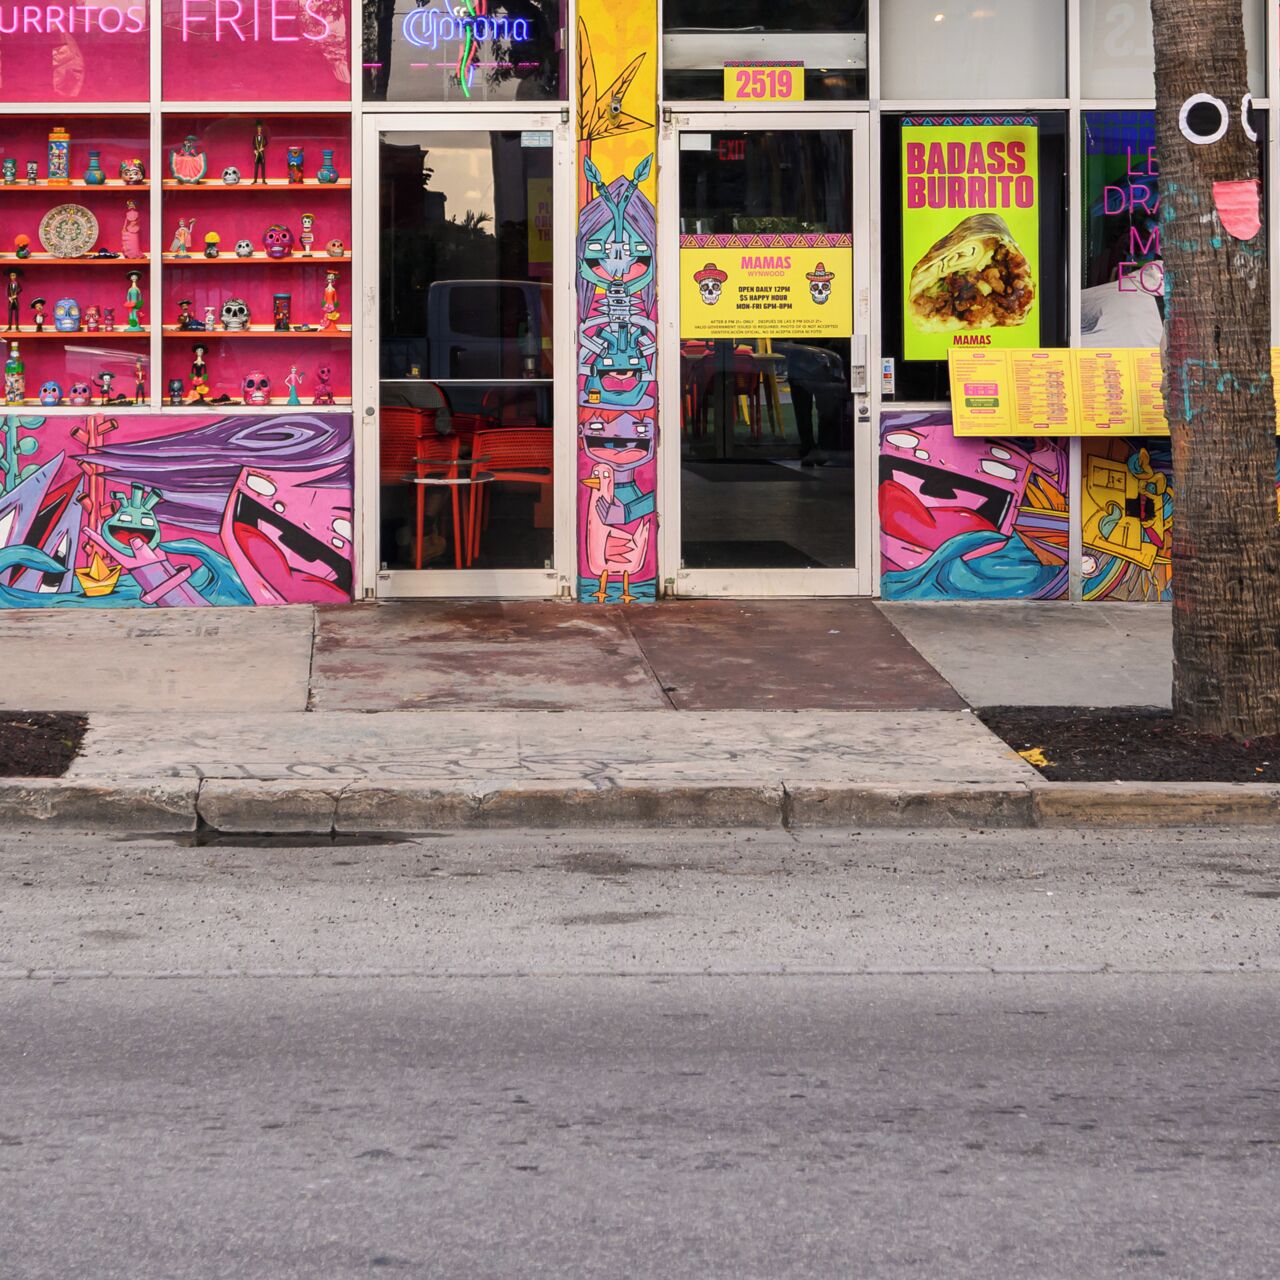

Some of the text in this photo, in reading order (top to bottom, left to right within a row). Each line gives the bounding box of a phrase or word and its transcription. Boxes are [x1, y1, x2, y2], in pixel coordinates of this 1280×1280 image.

[402, 8, 529, 50] Corona
[736, 70, 793, 98] 2519
[906, 141, 1026, 175] BADASS
[907, 175, 1034, 209] BURRITO
[741, 256, 792, 270] MAMAS
[738, 286, 791, 294] OPEN DAILY 12PM
[739, 294, 748, 302] $5
[953, 335, 992, 345] MAMAS
